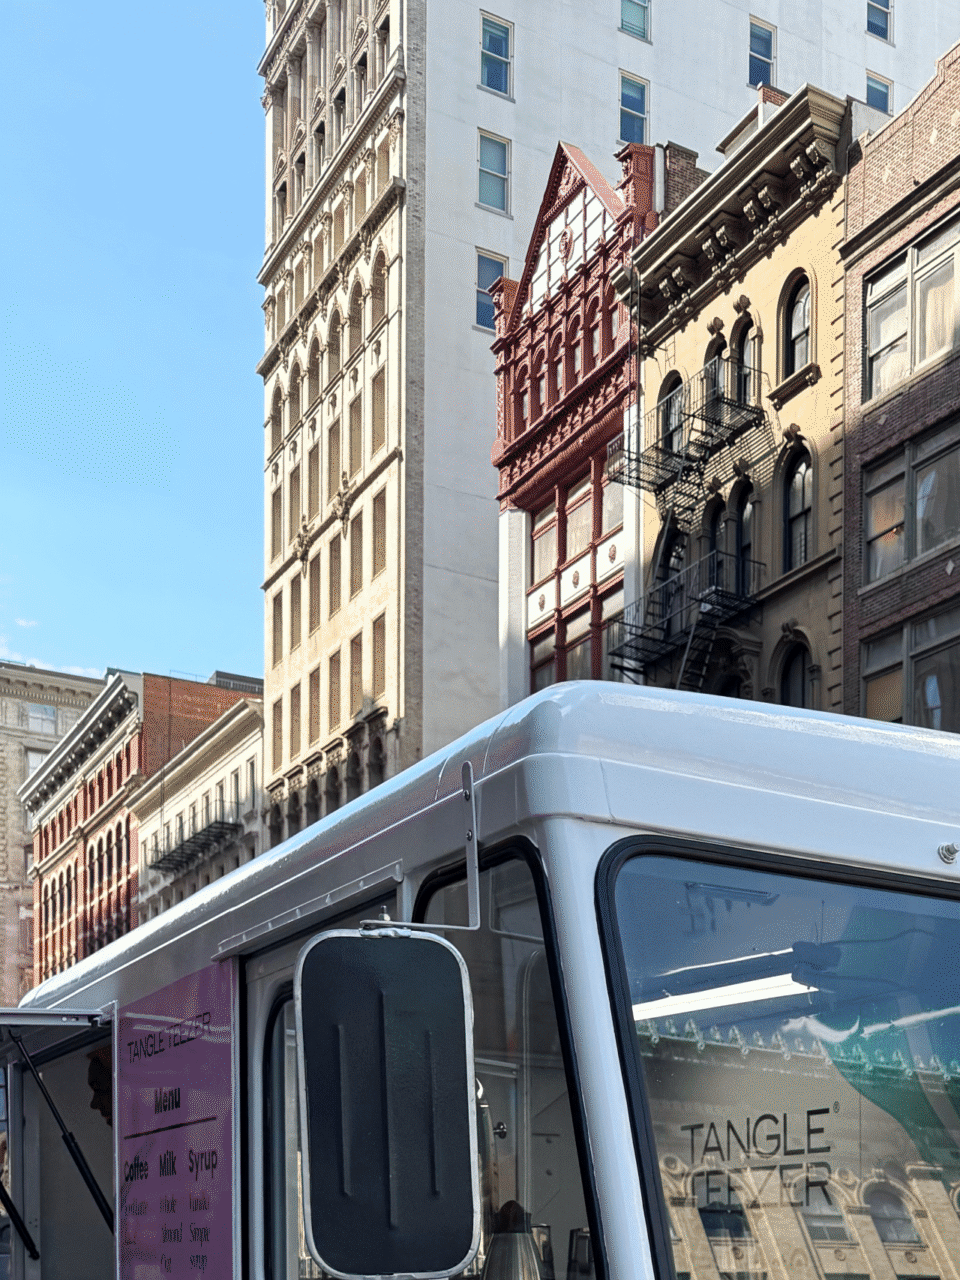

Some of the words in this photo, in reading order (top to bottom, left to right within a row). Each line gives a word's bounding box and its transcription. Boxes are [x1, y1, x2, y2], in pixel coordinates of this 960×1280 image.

[127, 1032, 166, 1064] TANGLE
[154, 1087, 181, 1115] Menu
[122, 1154, 149, 1183] Coffee
[159, 1149, 177, 1178] Milk
[188, 1149, 218, 1182] Syrup
[683, 1161, 834, 1209] TEEZER
